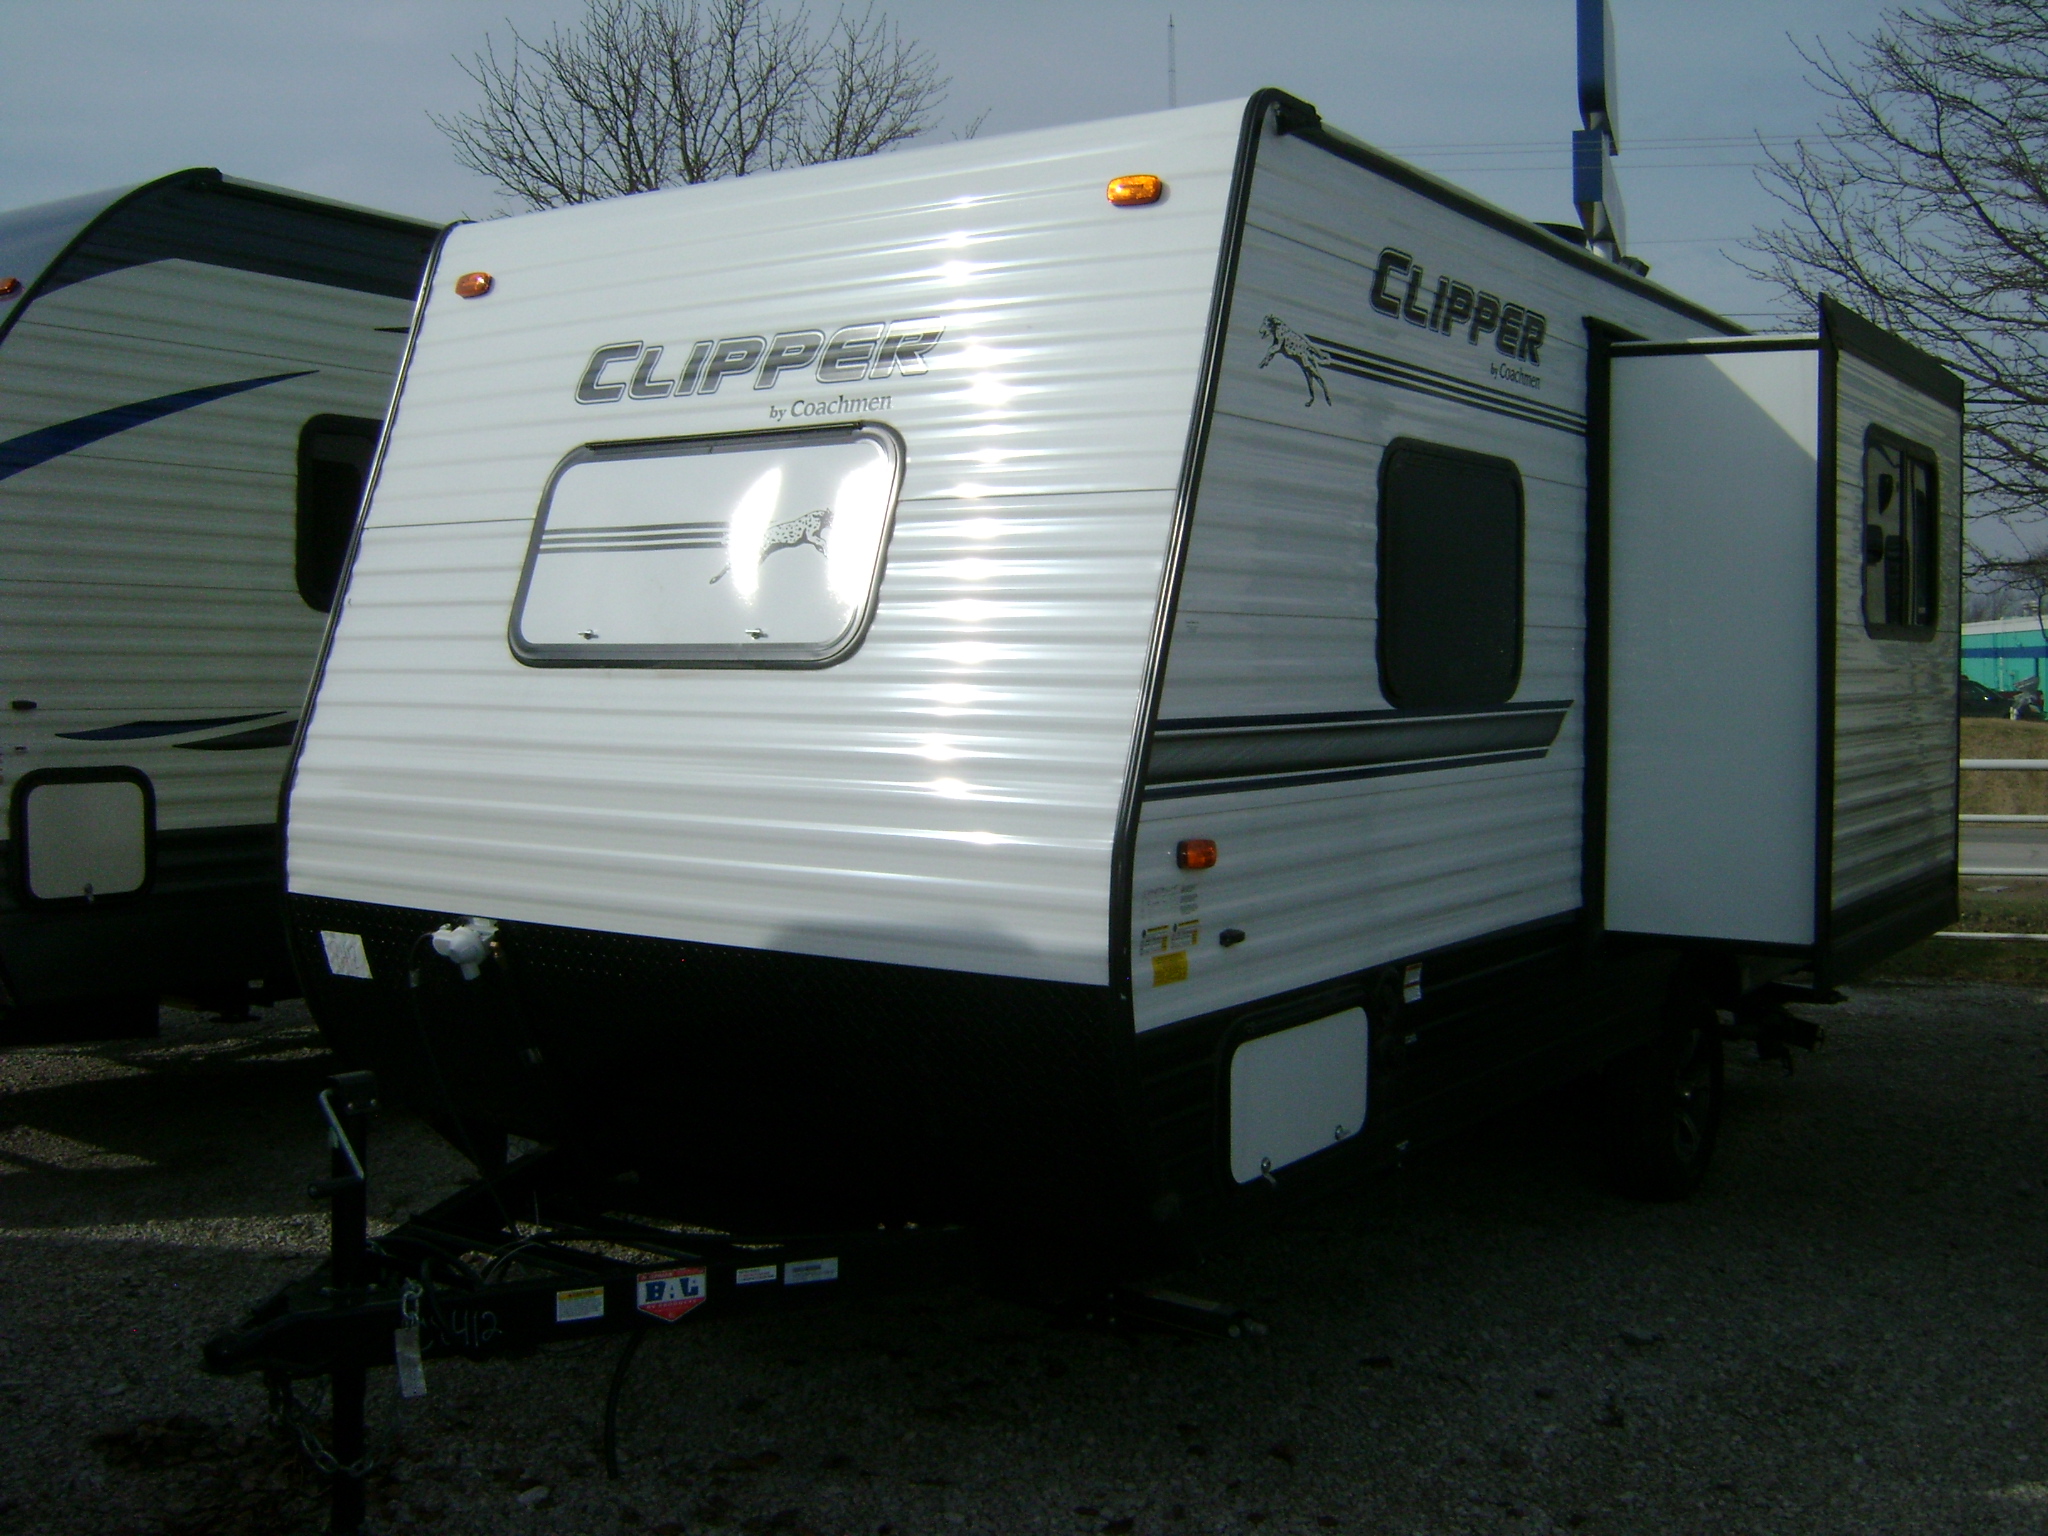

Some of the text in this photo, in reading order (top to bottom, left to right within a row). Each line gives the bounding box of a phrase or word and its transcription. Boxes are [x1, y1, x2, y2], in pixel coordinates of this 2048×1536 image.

[1369, 247, 1546, 367] CLIPPER
[575, 315, 947, 405] CLIPPER
[1490, 362, 1541, 390] by Coachmen
[769, 395, 892, 422] by Coachmen
